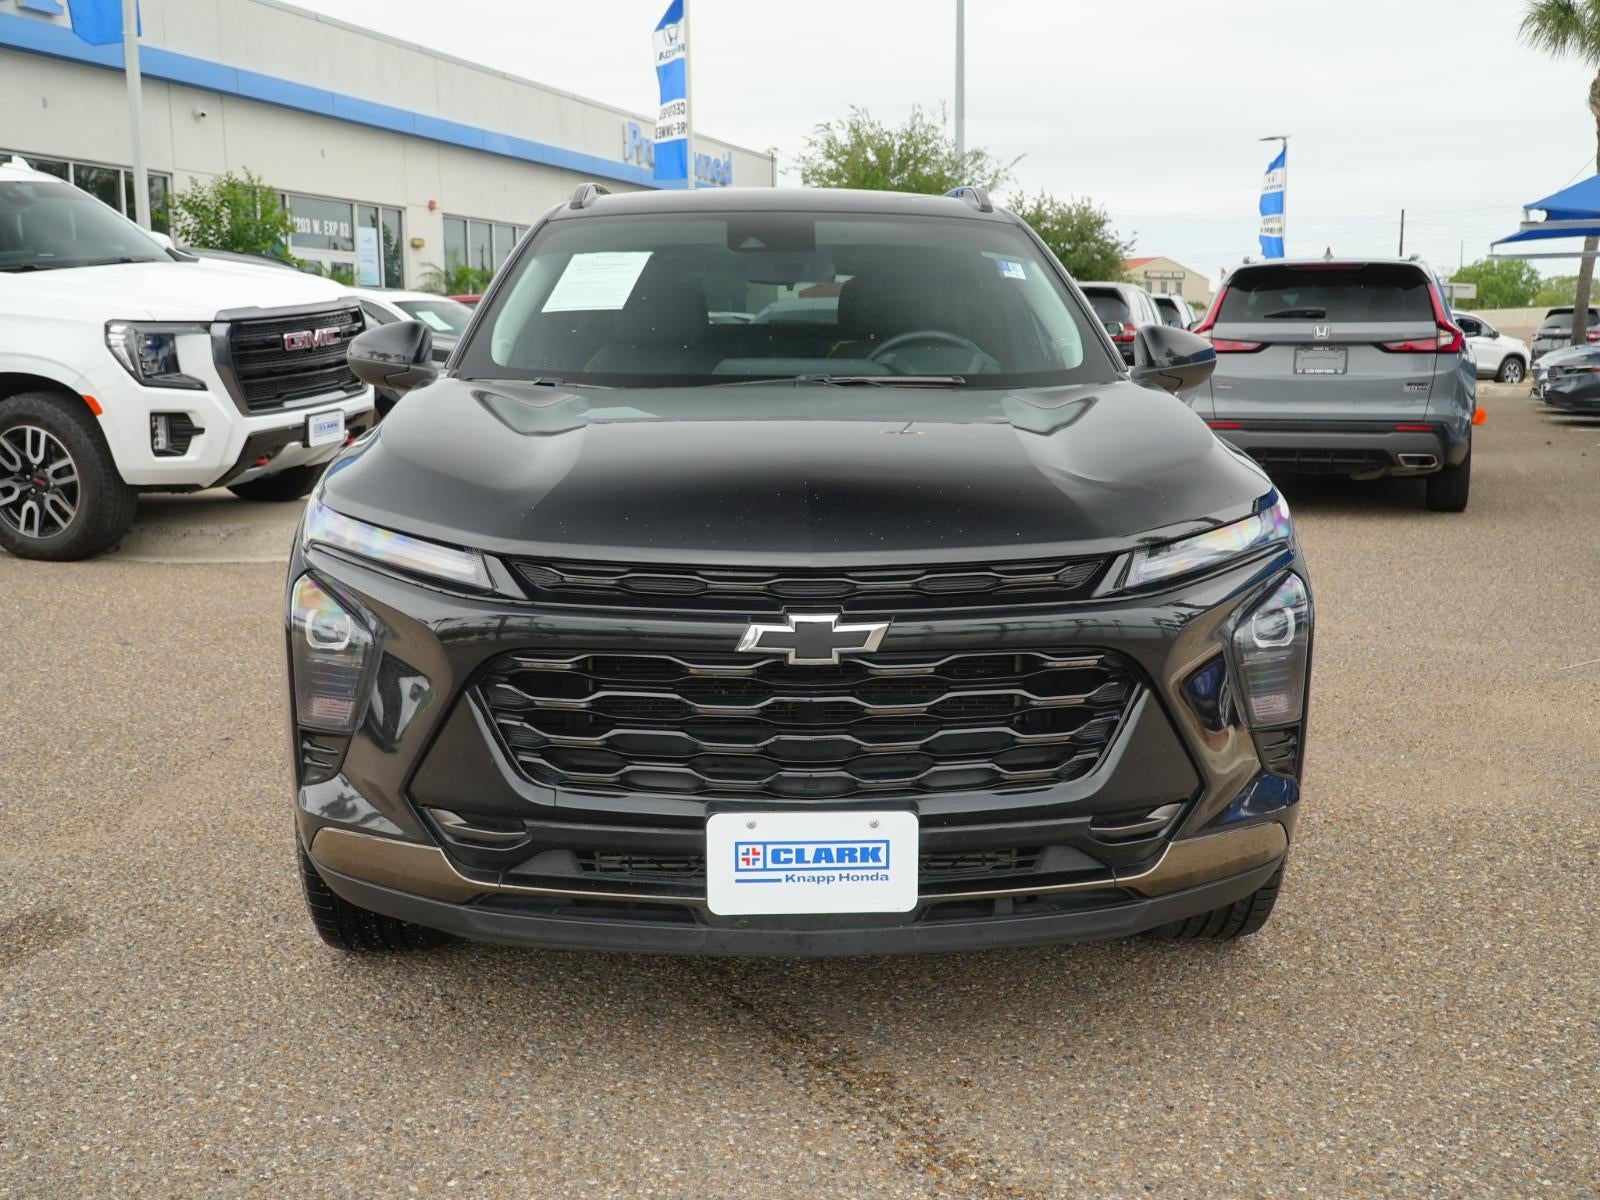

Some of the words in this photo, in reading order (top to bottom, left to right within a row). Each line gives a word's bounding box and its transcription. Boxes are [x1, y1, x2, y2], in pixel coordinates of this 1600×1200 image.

[323, 220, 338, 237] EXP
[283, 326, 341, 351] GMC
[770, 846, 883, 865] CLARK
[785, 873, 836, 885] Knapp
[838, 872, 890, 882] Honda
